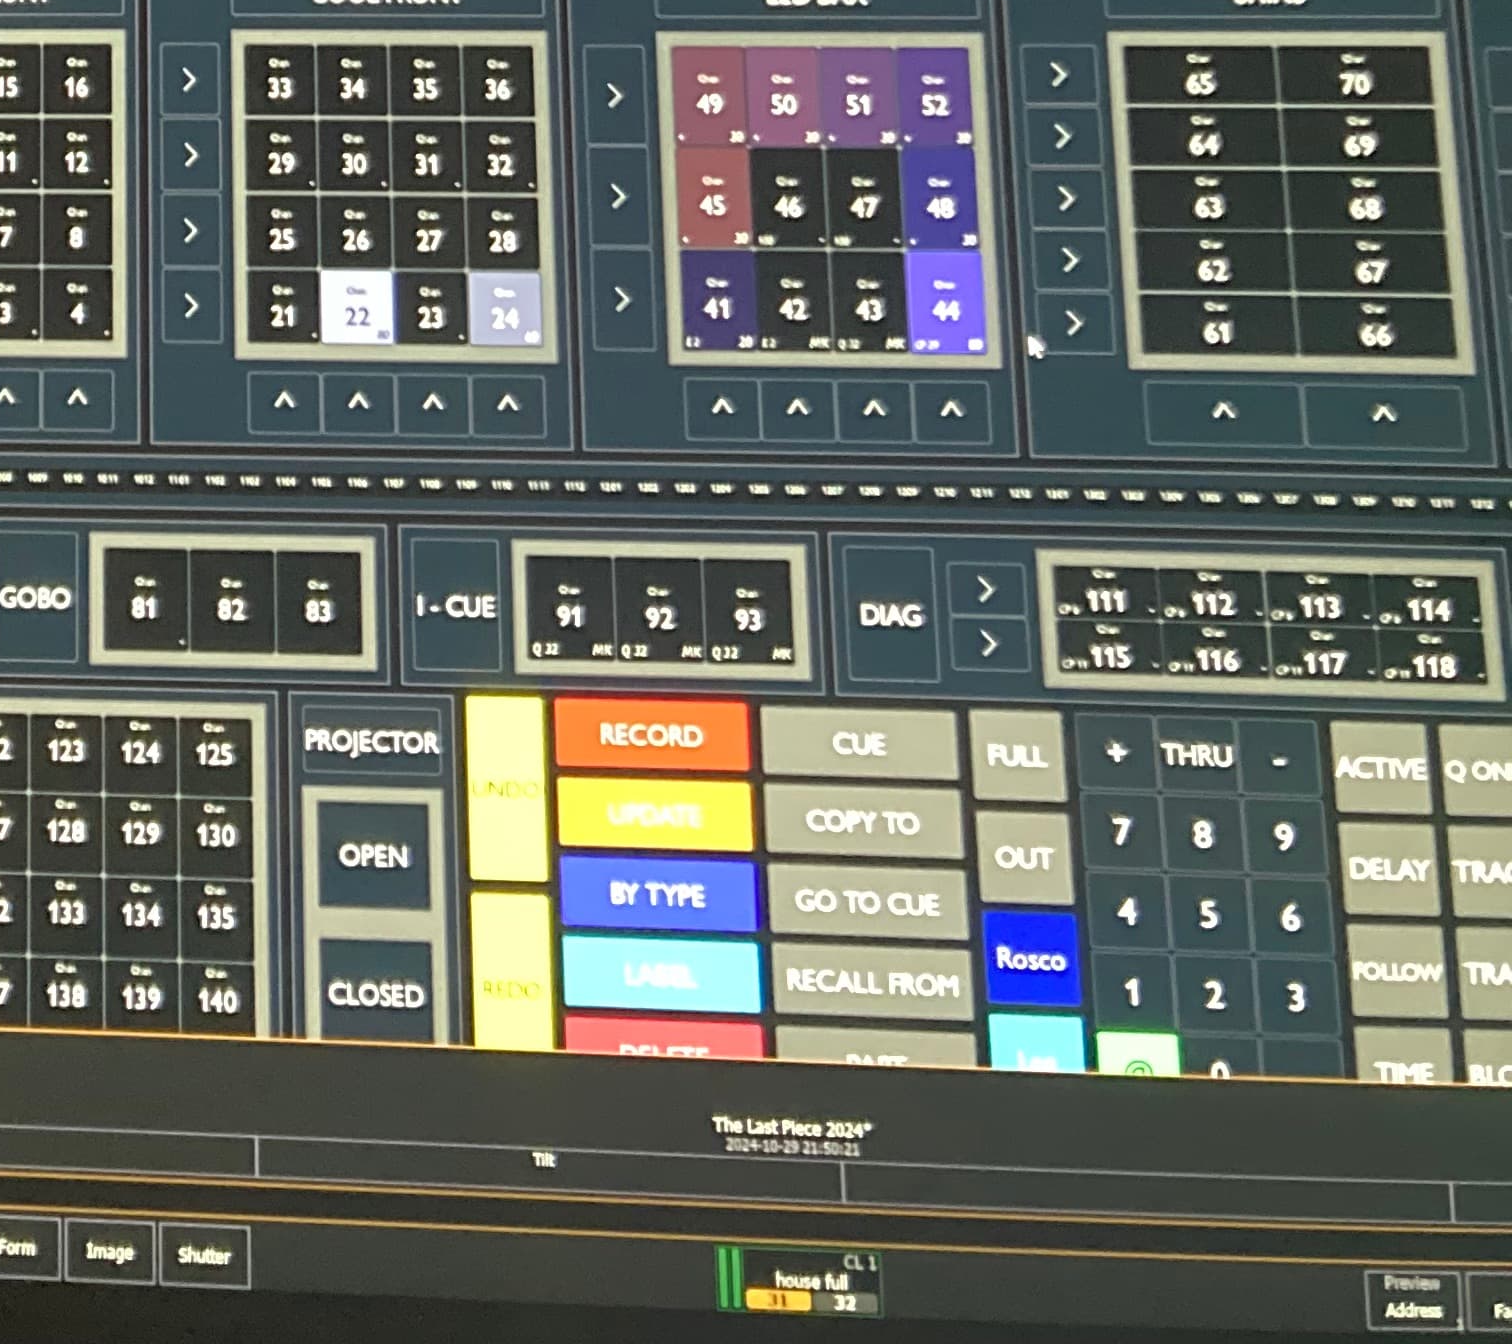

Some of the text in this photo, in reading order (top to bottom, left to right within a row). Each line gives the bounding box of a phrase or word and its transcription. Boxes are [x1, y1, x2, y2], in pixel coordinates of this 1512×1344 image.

[65, 76, 89, 98] 16
[268, 77, 292, 99] 33
[1186, 72, 1216, 95] 65
[1339, 72, 1372, 95] 70
[697, 93, 724, 114] 49
[922, 94, 950, 116] 52
[271, 304, 295, 327] 21
[345, 308, 369, 326] 22
[491, 307, 520, 329] 24
[704, 297, 730, 319] 41
[933, 300, 960, 321] 44
[1360, 324, 1394, 346] 66
[0, 586, 72, 609] GOBO
[132, 596, 157, 619] 81
[417, 595, 425, 616] I
[446, 595, 496, 618] CUE
[1086, 589, 1126, 612] 111
[306, 599, 333, 622] 83
[557, 604, 584, 627] 91
[734, 608, 763, 631] 93
[860, 603, 925, 627] DIAG
[1408, 599, 1451, 621] 114
[305, 728, 441, 758] PROJECTOR
[600, 723, 704, 747] RECORD
[833, 731, 887, 756] CUE
[48, 738, 85, 762] 123
[196, 742, 235, 766] 125
[987, 744, 1048, 768] FULL
[1160, 742, 1233, 767] THRU
[1336, 756, 1427, 780] ACTIVE
[472, 780, 539, 798] UNDO
[609, 806, 700, 827] UPDATE
[806, 808, 920, 835] COPY TO
[1112, 817, 1132, 845] 7
[1274, 823, 1294, 851] 9
[339, 843, 409, 868] OPEN
[995, 845, 1056, 870] OUT
[1349, 857, 1432, 881] DELAY
[610, 881, 705, 908] BY TYPE
[795, 888, 940, 916] GO TO CUE
[1200, 900, 1218, 928] 5
[996, 945, 1066, 971] Rosco
[624, 964, 697, 988] LABEL
[786, 968, 960, 997] RECALL FROM
[1352, 961, 1443, 982] FOLLOW
[199, 987, 240, 1013] 140
[328, 980, 424, 1008] CLOSED
[483, 980, 542, 998] REDO
[1125, 978, 1139, 1006] 1
[1287, 983, 1305, 1012] 3
[1374, 1062, 1433, 1083] TIME
[712, 1116, 743, 1133] The
[747, 1118, 779, 1135] Last
[782, 1119, 822, 1137] Piece
[532, 1152, 556, 1167] Tilt
[86, 1241, 135, 1264] Image
[178, 1246, 232, 1264] Shutter
[844, 1253, 877, 1271] CL 1
[776, 1270, 848, 1290] house full
[1384, 1275, 1440, 1290] Preview
[833, 1294, 856, 1311] 32
[1385, 1302, 1443, 1318] Address
